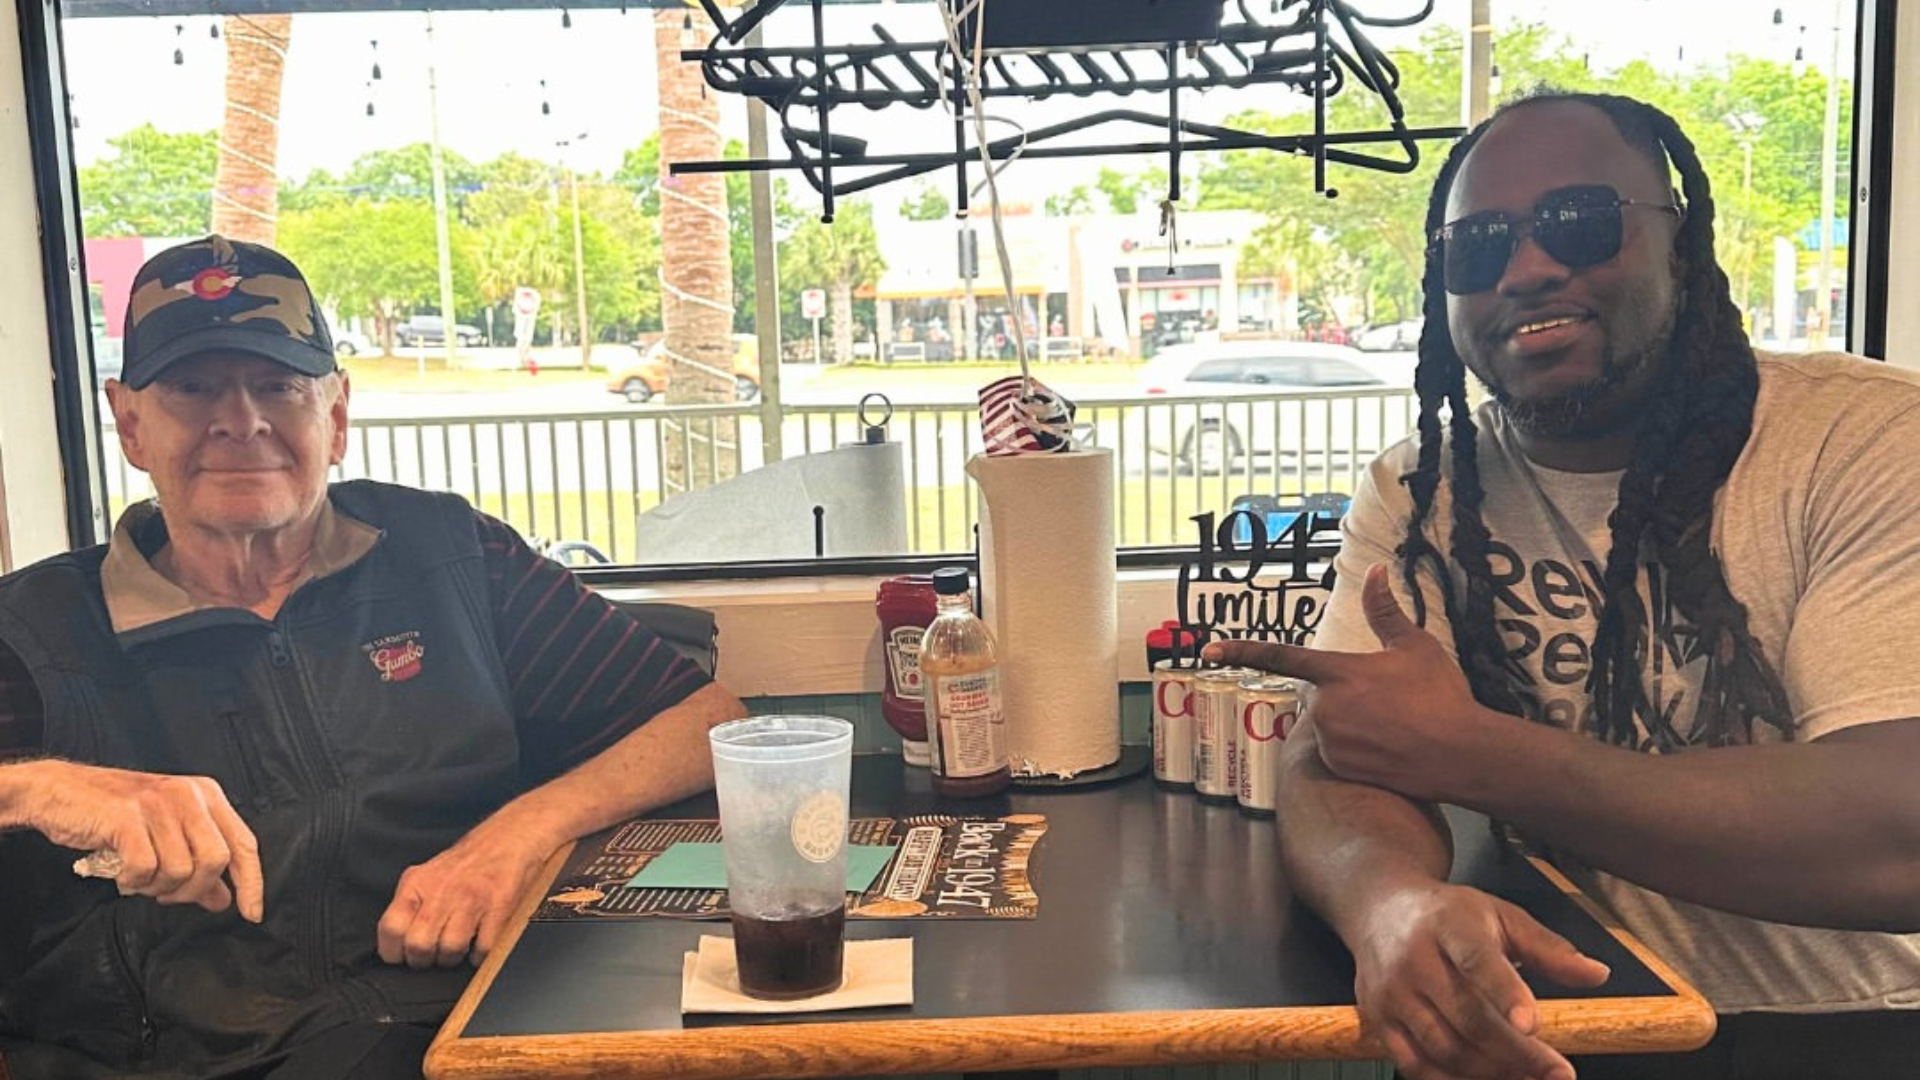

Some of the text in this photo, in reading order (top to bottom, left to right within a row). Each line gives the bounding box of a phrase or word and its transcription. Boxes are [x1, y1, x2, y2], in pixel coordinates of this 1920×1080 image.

[1177, 563, 1329, 629] Limite
[899, 636, 922, 645] HEIN
[1227, 740, 1238, 787] RECYCLE
[953, 822, 1005, 860] Back
[936, 867, 997, 909] 1947
